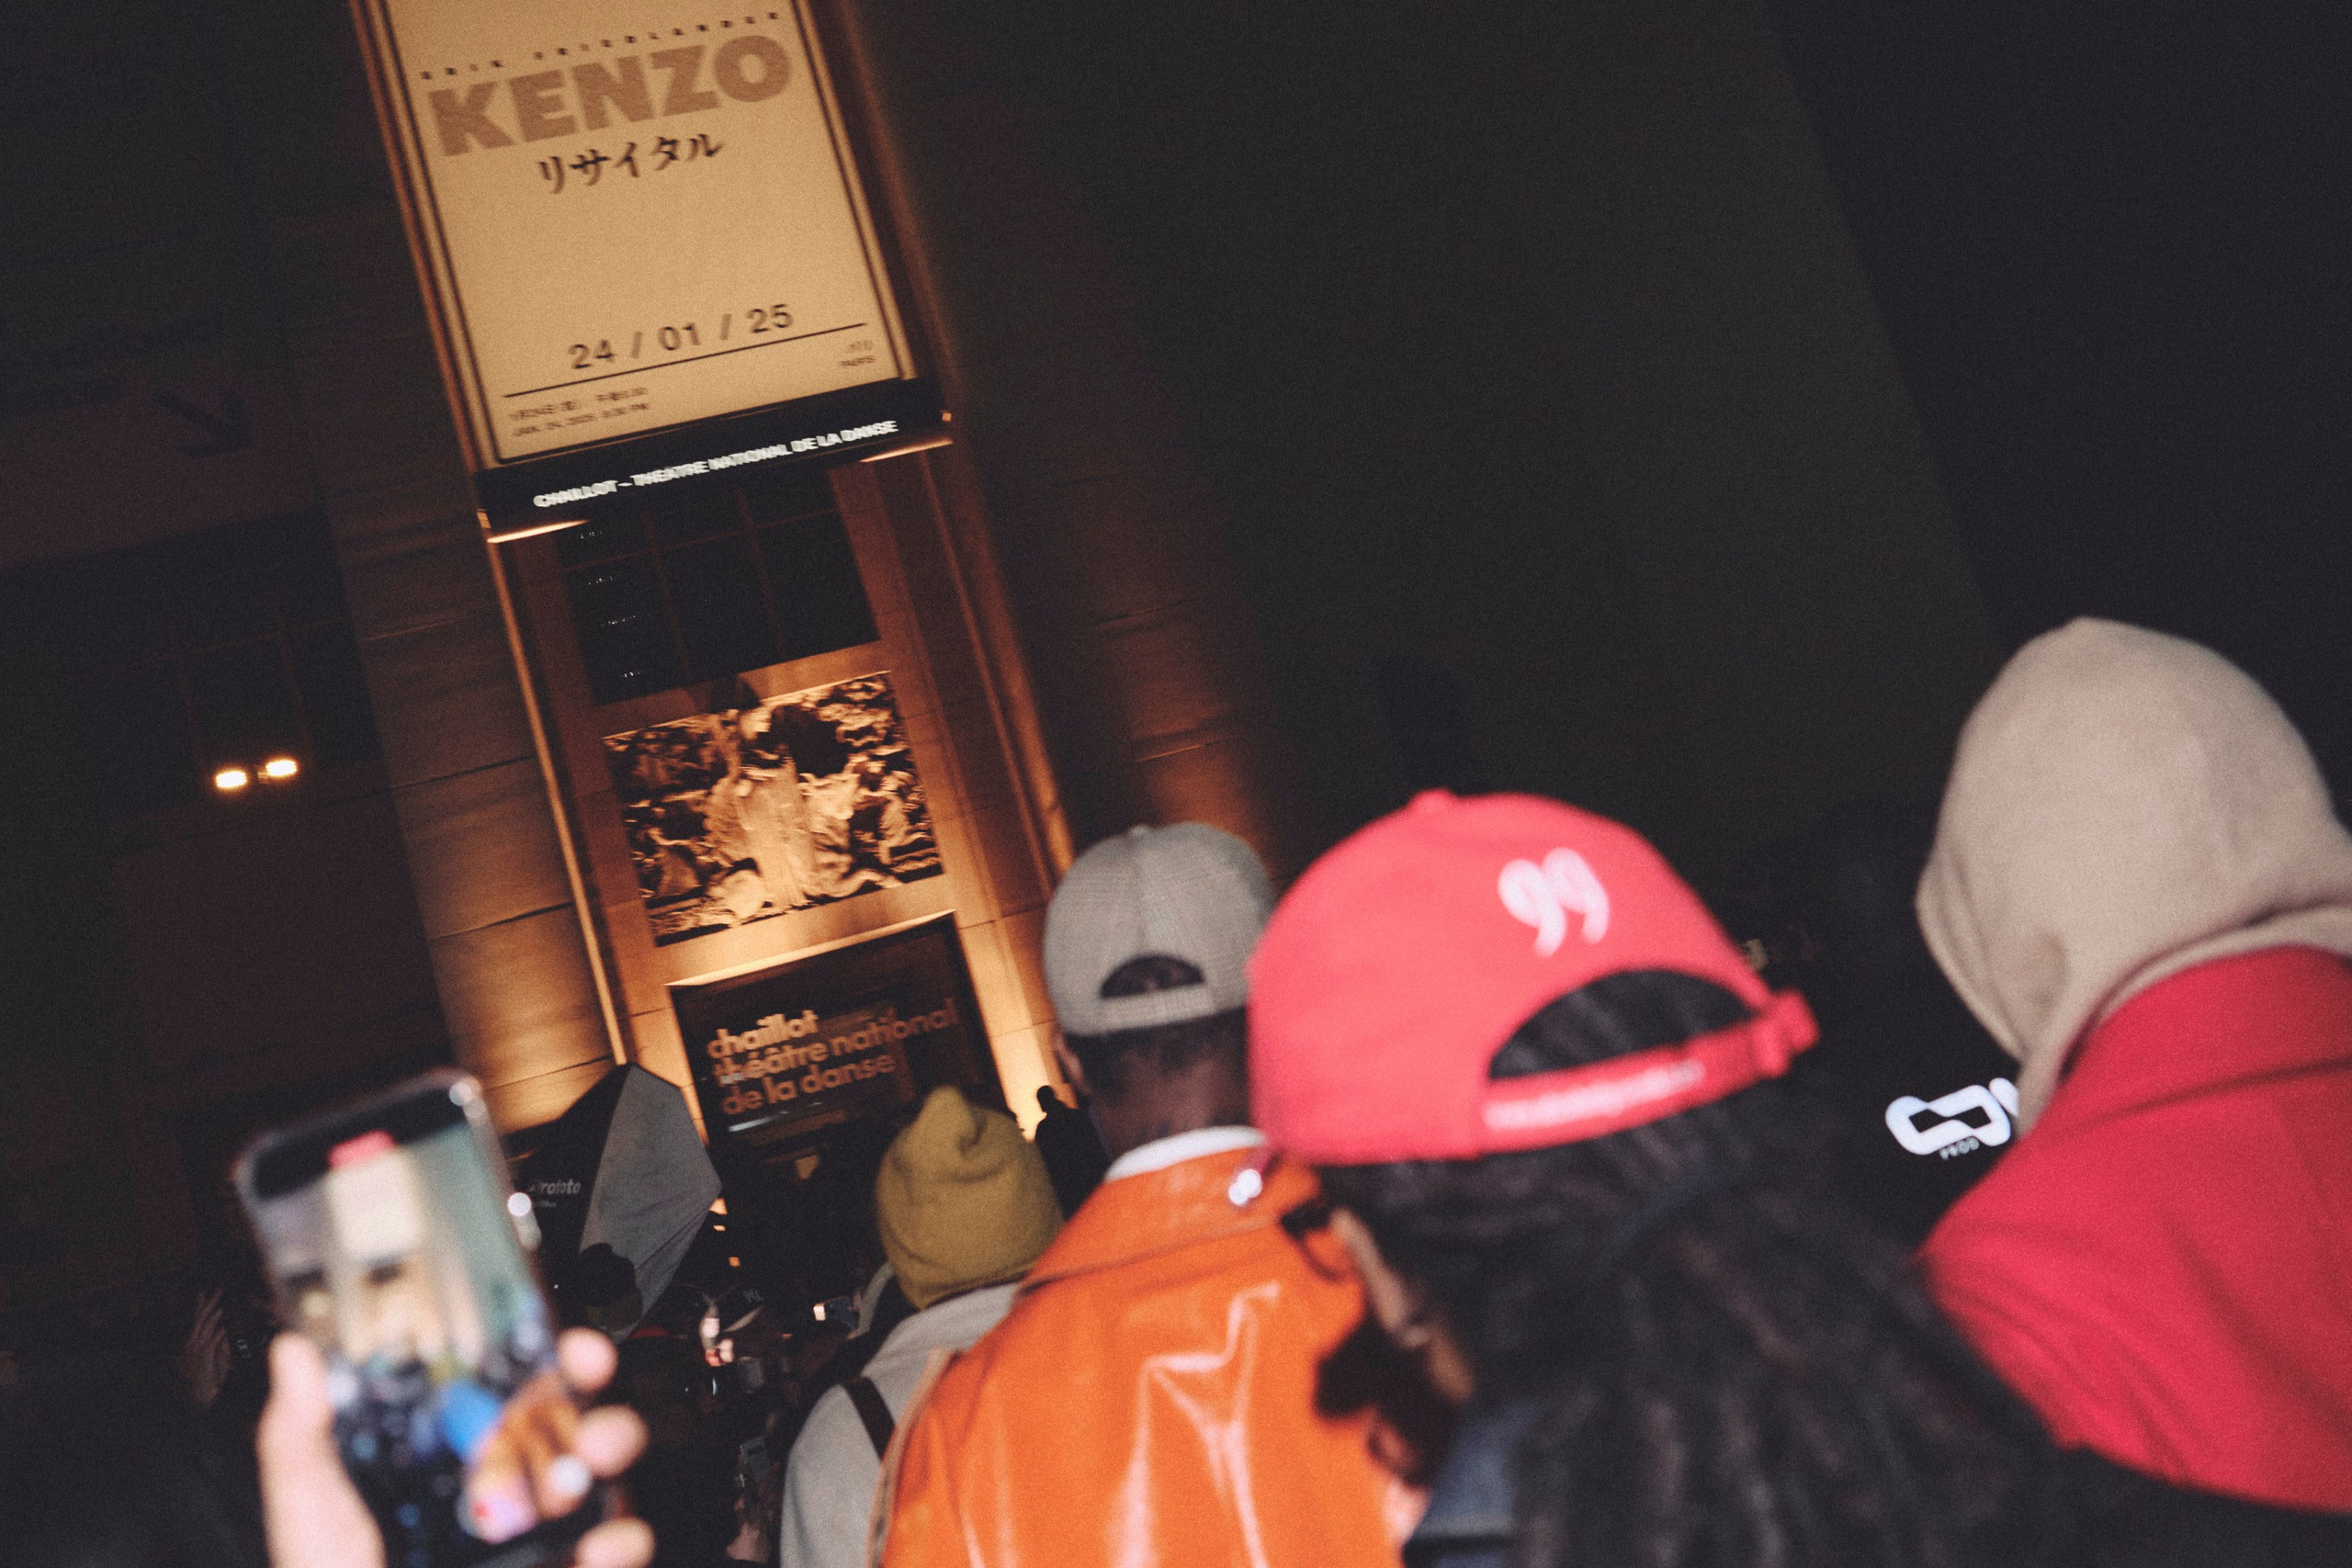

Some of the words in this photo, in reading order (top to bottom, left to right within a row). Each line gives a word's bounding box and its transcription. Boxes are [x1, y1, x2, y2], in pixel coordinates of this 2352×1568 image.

[428, 35, 793, 156] KENZO
[539, 133, 723, 194] リサイタル
[567, 339, 614, 369] 24
[657, 321, 701, 351] 01
[745, 303, 794, 333] 25
[533, 480, 618, 507] CHAILLOT
[707, 444, 793, 470] NATIONAL
[790, 437, 819, 452] DE
[816, 433, 842, 447] LA
[840, 420, 899, 442] DANSE
[829, 998, 960, 1056] national
[721, 1085, 763, 1115] de
[763, 1075, 797, 1104] la
[799, 1054, 896, 1094] danse
